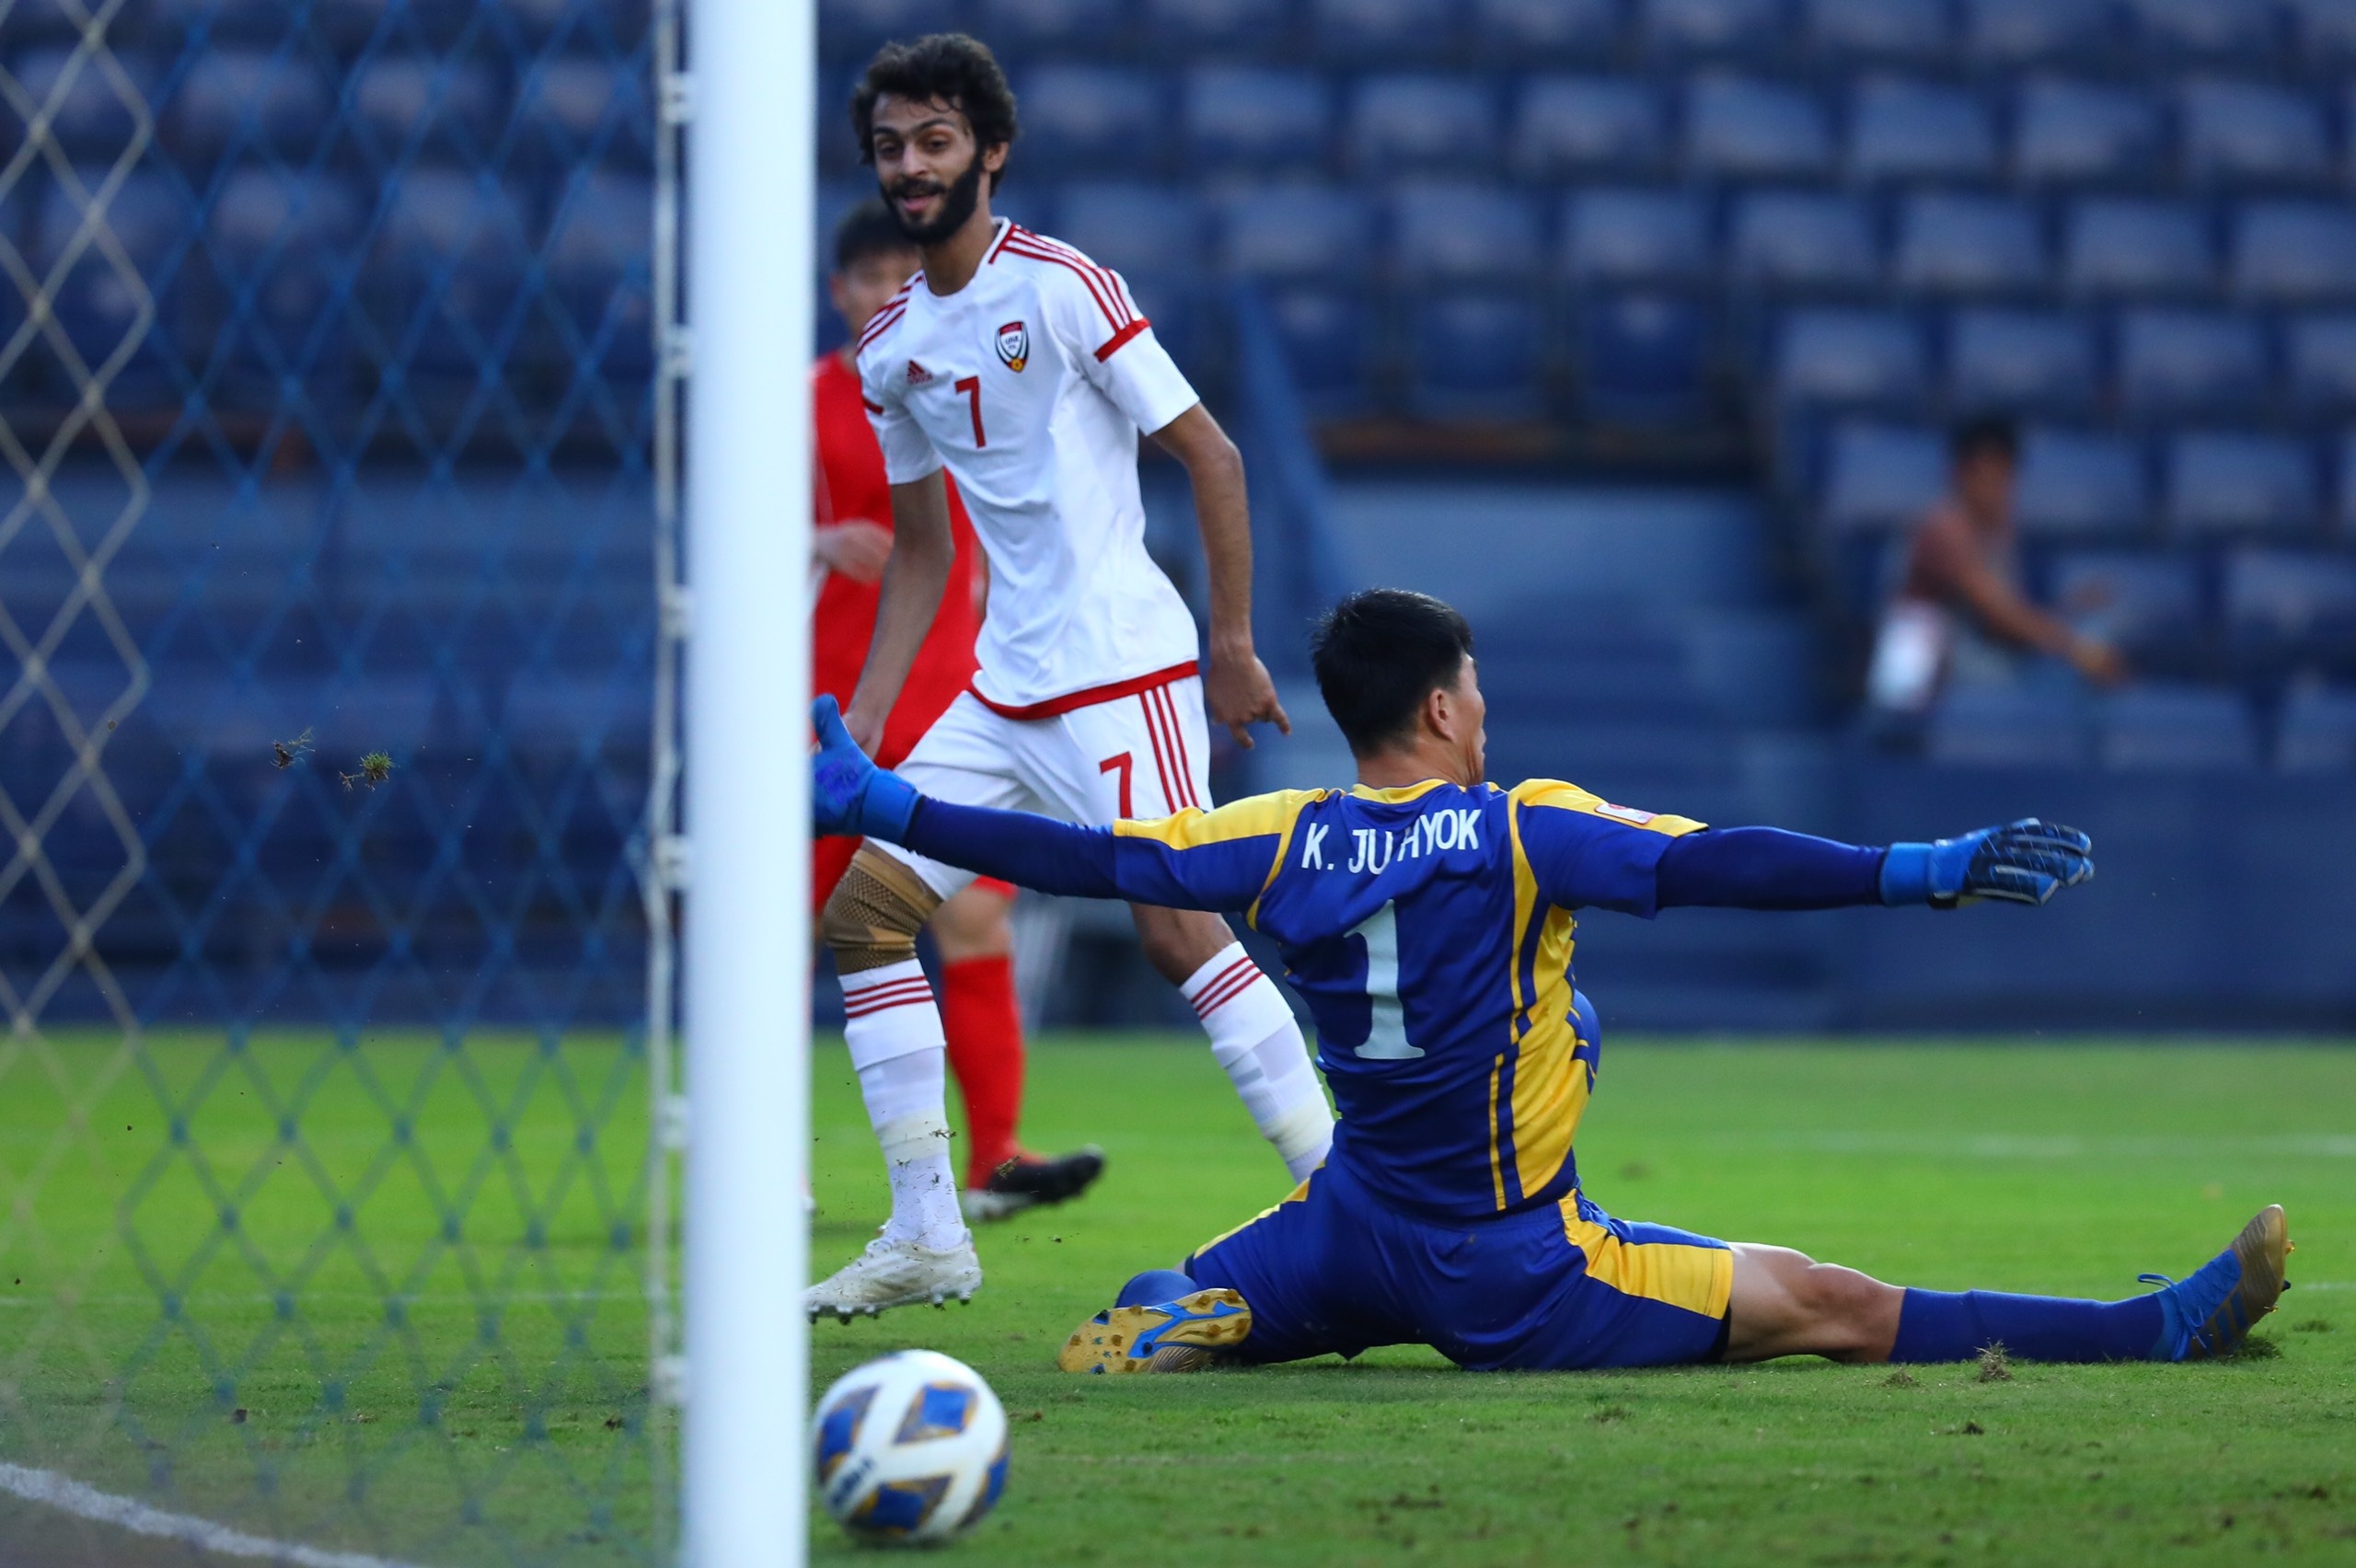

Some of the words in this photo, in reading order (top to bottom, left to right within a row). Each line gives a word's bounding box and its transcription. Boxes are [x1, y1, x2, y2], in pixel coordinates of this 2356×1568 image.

[954, 375, 987, 448] 7
[1099, 750, 1133, 819] 7
[1301, 823, 1334, 870] K.
[1343, 899, 1426, 1060] 1
